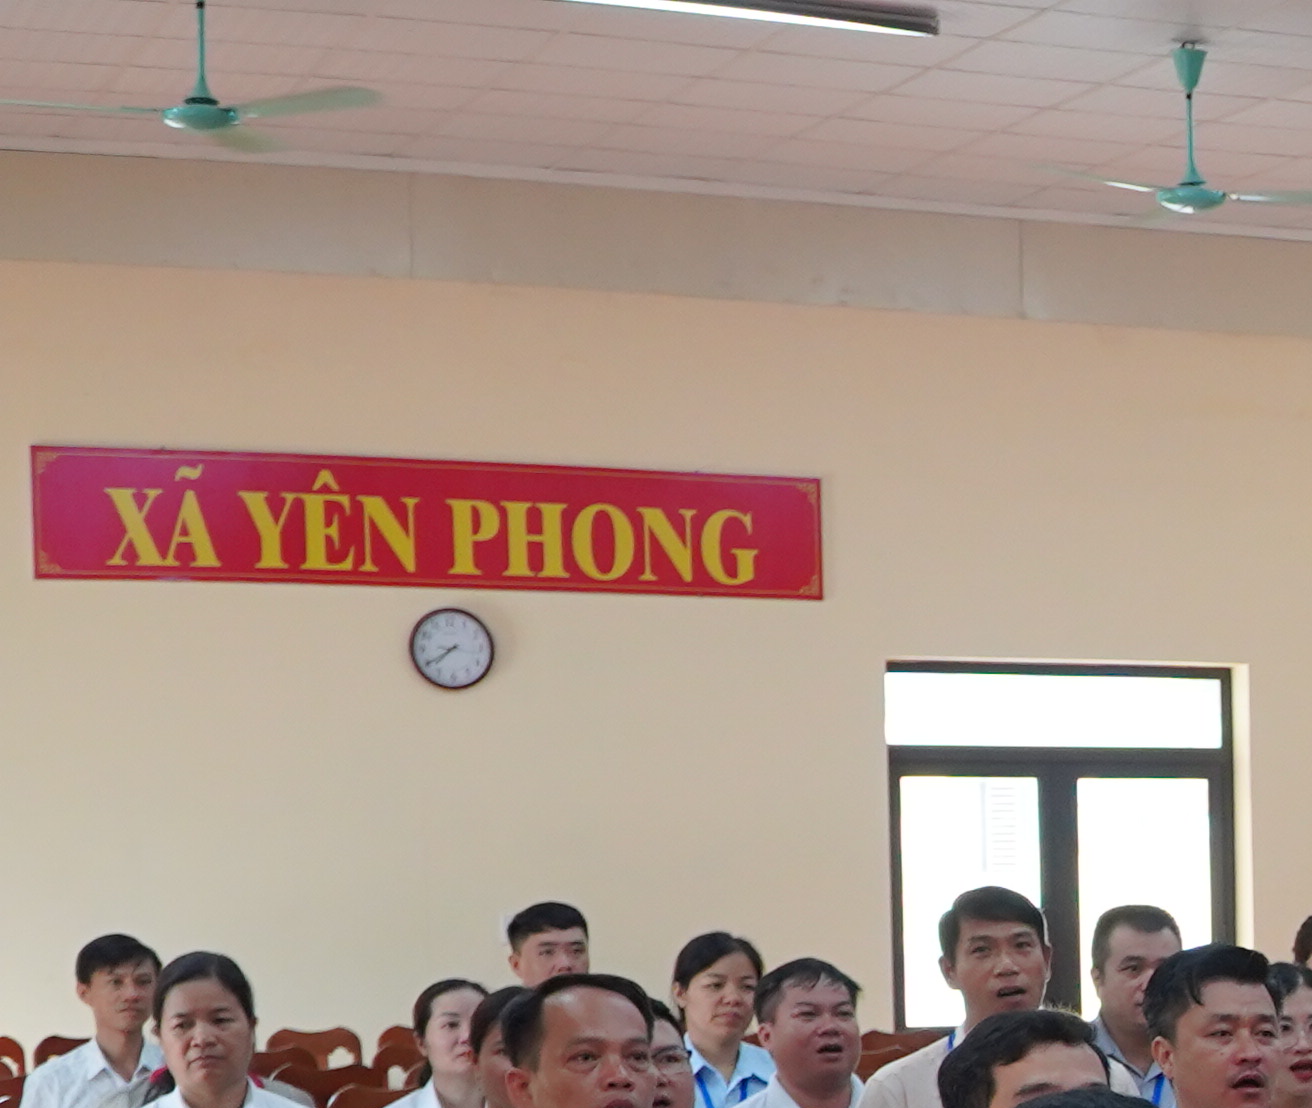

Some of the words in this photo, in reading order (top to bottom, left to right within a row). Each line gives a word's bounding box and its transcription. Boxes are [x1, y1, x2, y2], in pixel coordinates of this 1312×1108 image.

[105, 463, 222, 568] XÃ
[237, 469, 420, 573] YÊN
[446, 498, 759, 586] PHONG
